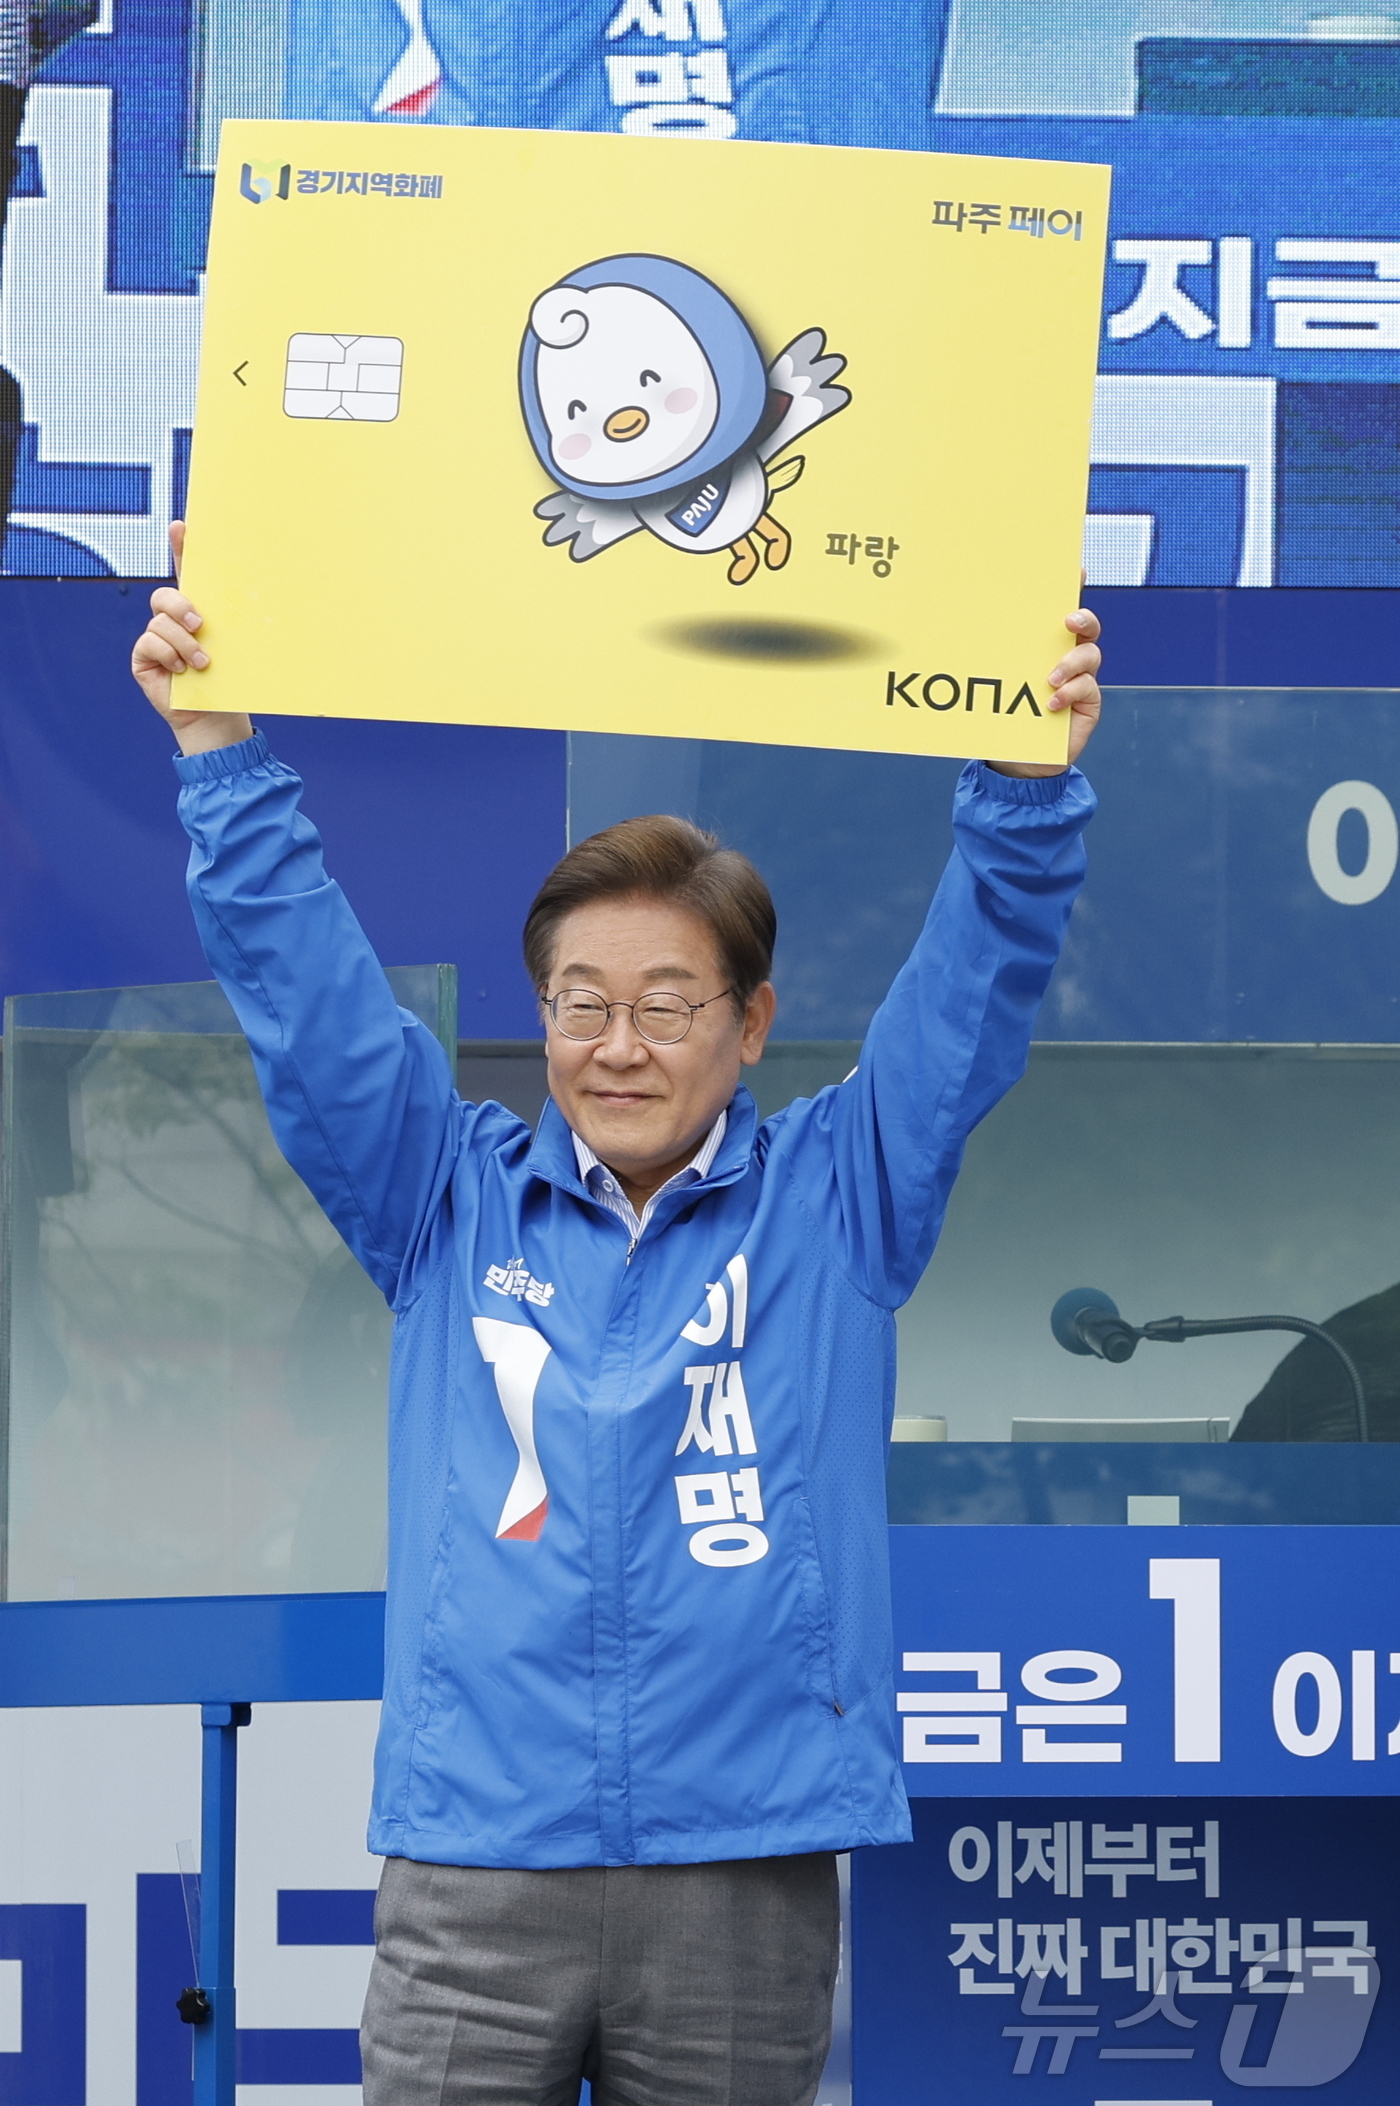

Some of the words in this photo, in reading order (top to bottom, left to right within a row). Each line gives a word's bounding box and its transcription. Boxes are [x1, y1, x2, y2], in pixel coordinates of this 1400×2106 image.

[297, 170, 443, 199] 경기지역화폐
[932, 201, 1001, 234] 파주
[1008, 206, 1083, 241] 페이
[1107, 235, 1400, 350] 지금
[681, 483, 719, 527] PAJU
[825, 533, 900, 578] 파랑
[483, 1264, 555, 1307] 민주당
[675, 1253, 769, 1567] 이재명
[1149, 1558, 1221, 1762] 1
[948, 1821, 1220, 1898] 이제부터
[948, 1918, 1088, 1995] 진짜
[1100, 1918, 1376, 1995] 대한민국
